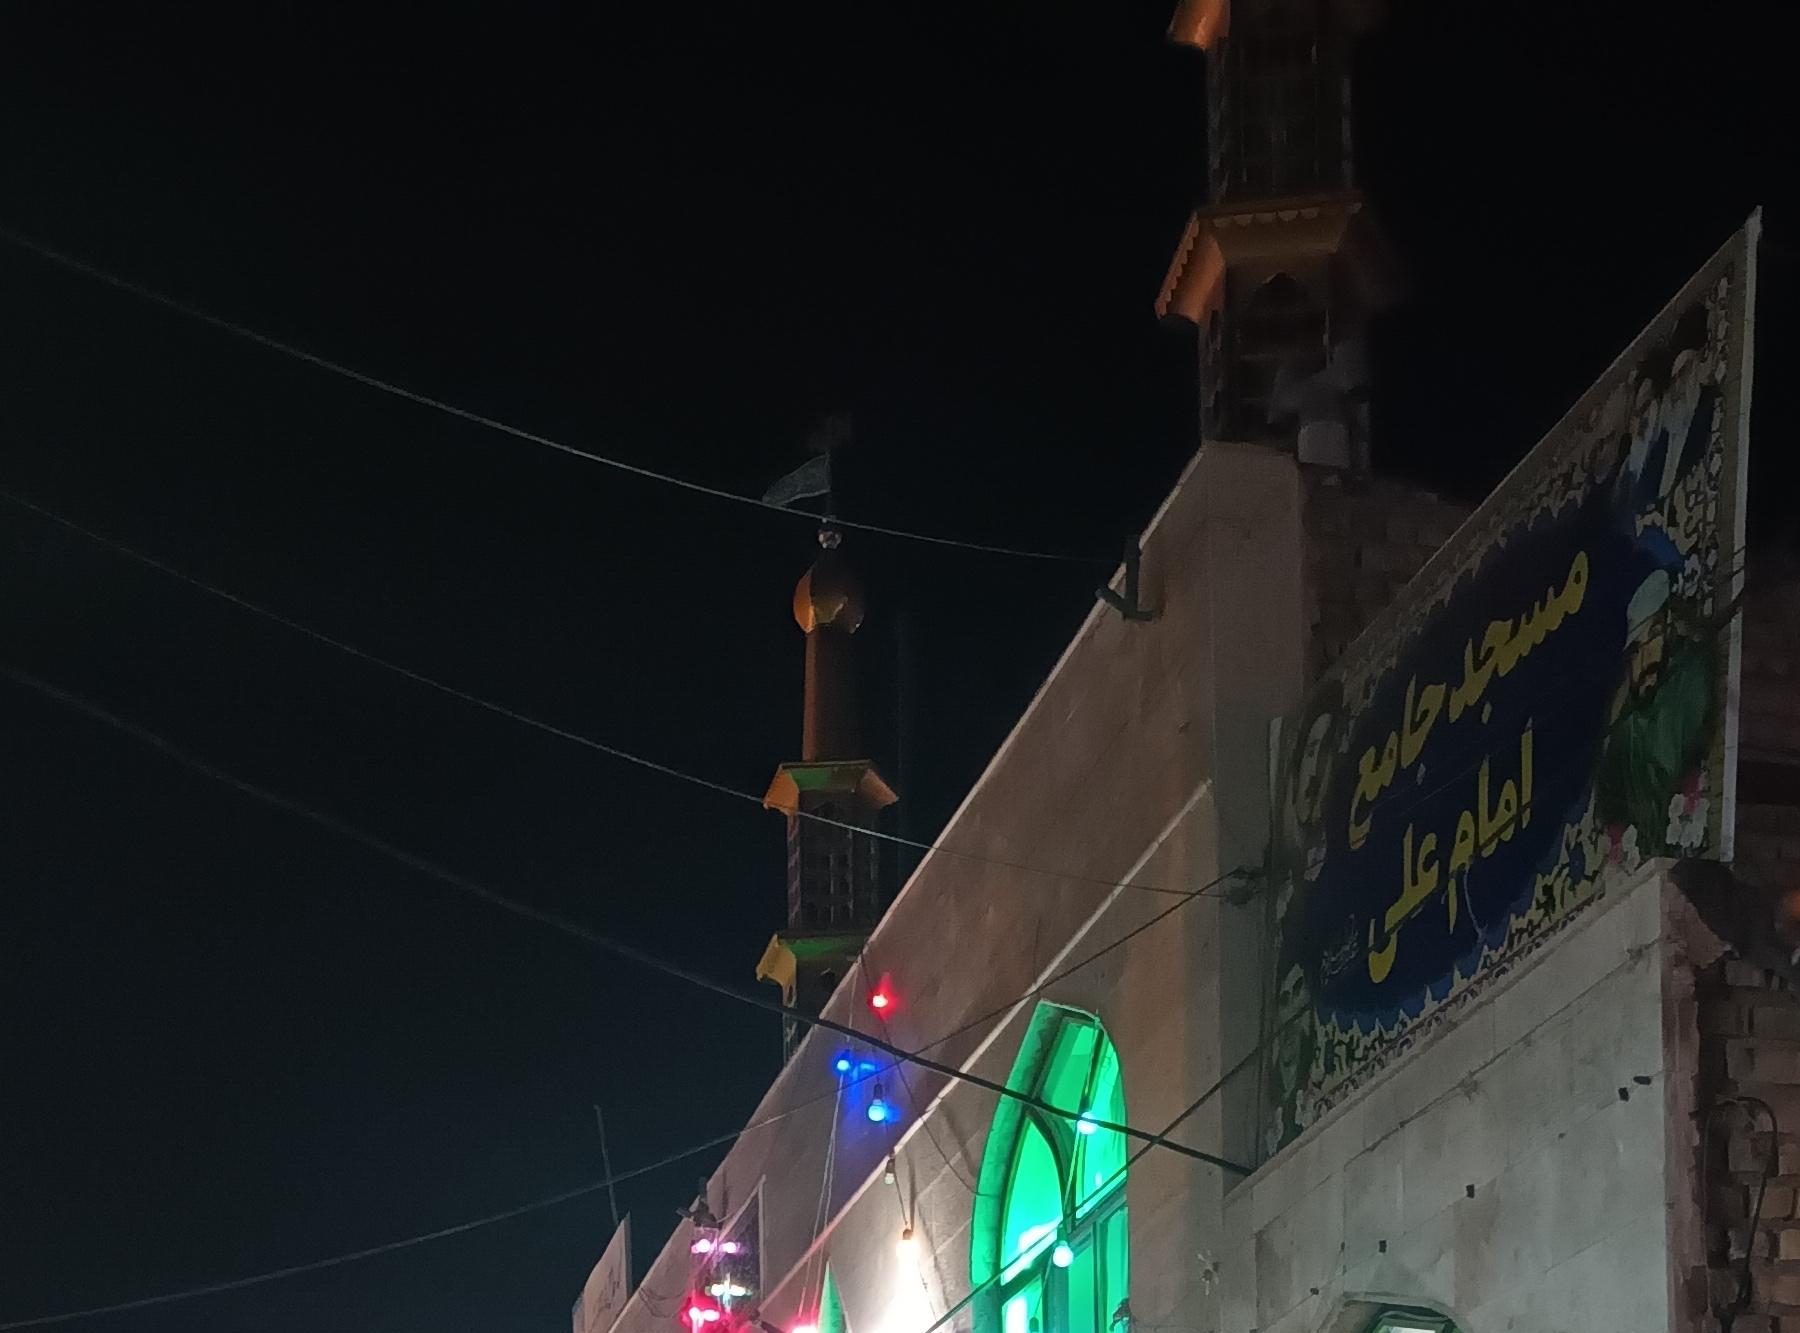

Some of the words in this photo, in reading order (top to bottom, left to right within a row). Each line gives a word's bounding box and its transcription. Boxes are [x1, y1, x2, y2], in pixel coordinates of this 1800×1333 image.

[1449, 550, 1590, 724] مسجد
[1347, 673, 1447, 851] جامع
[1447, 714, 1534, 935] امام
[1367, 822, 1440, 985] علی
